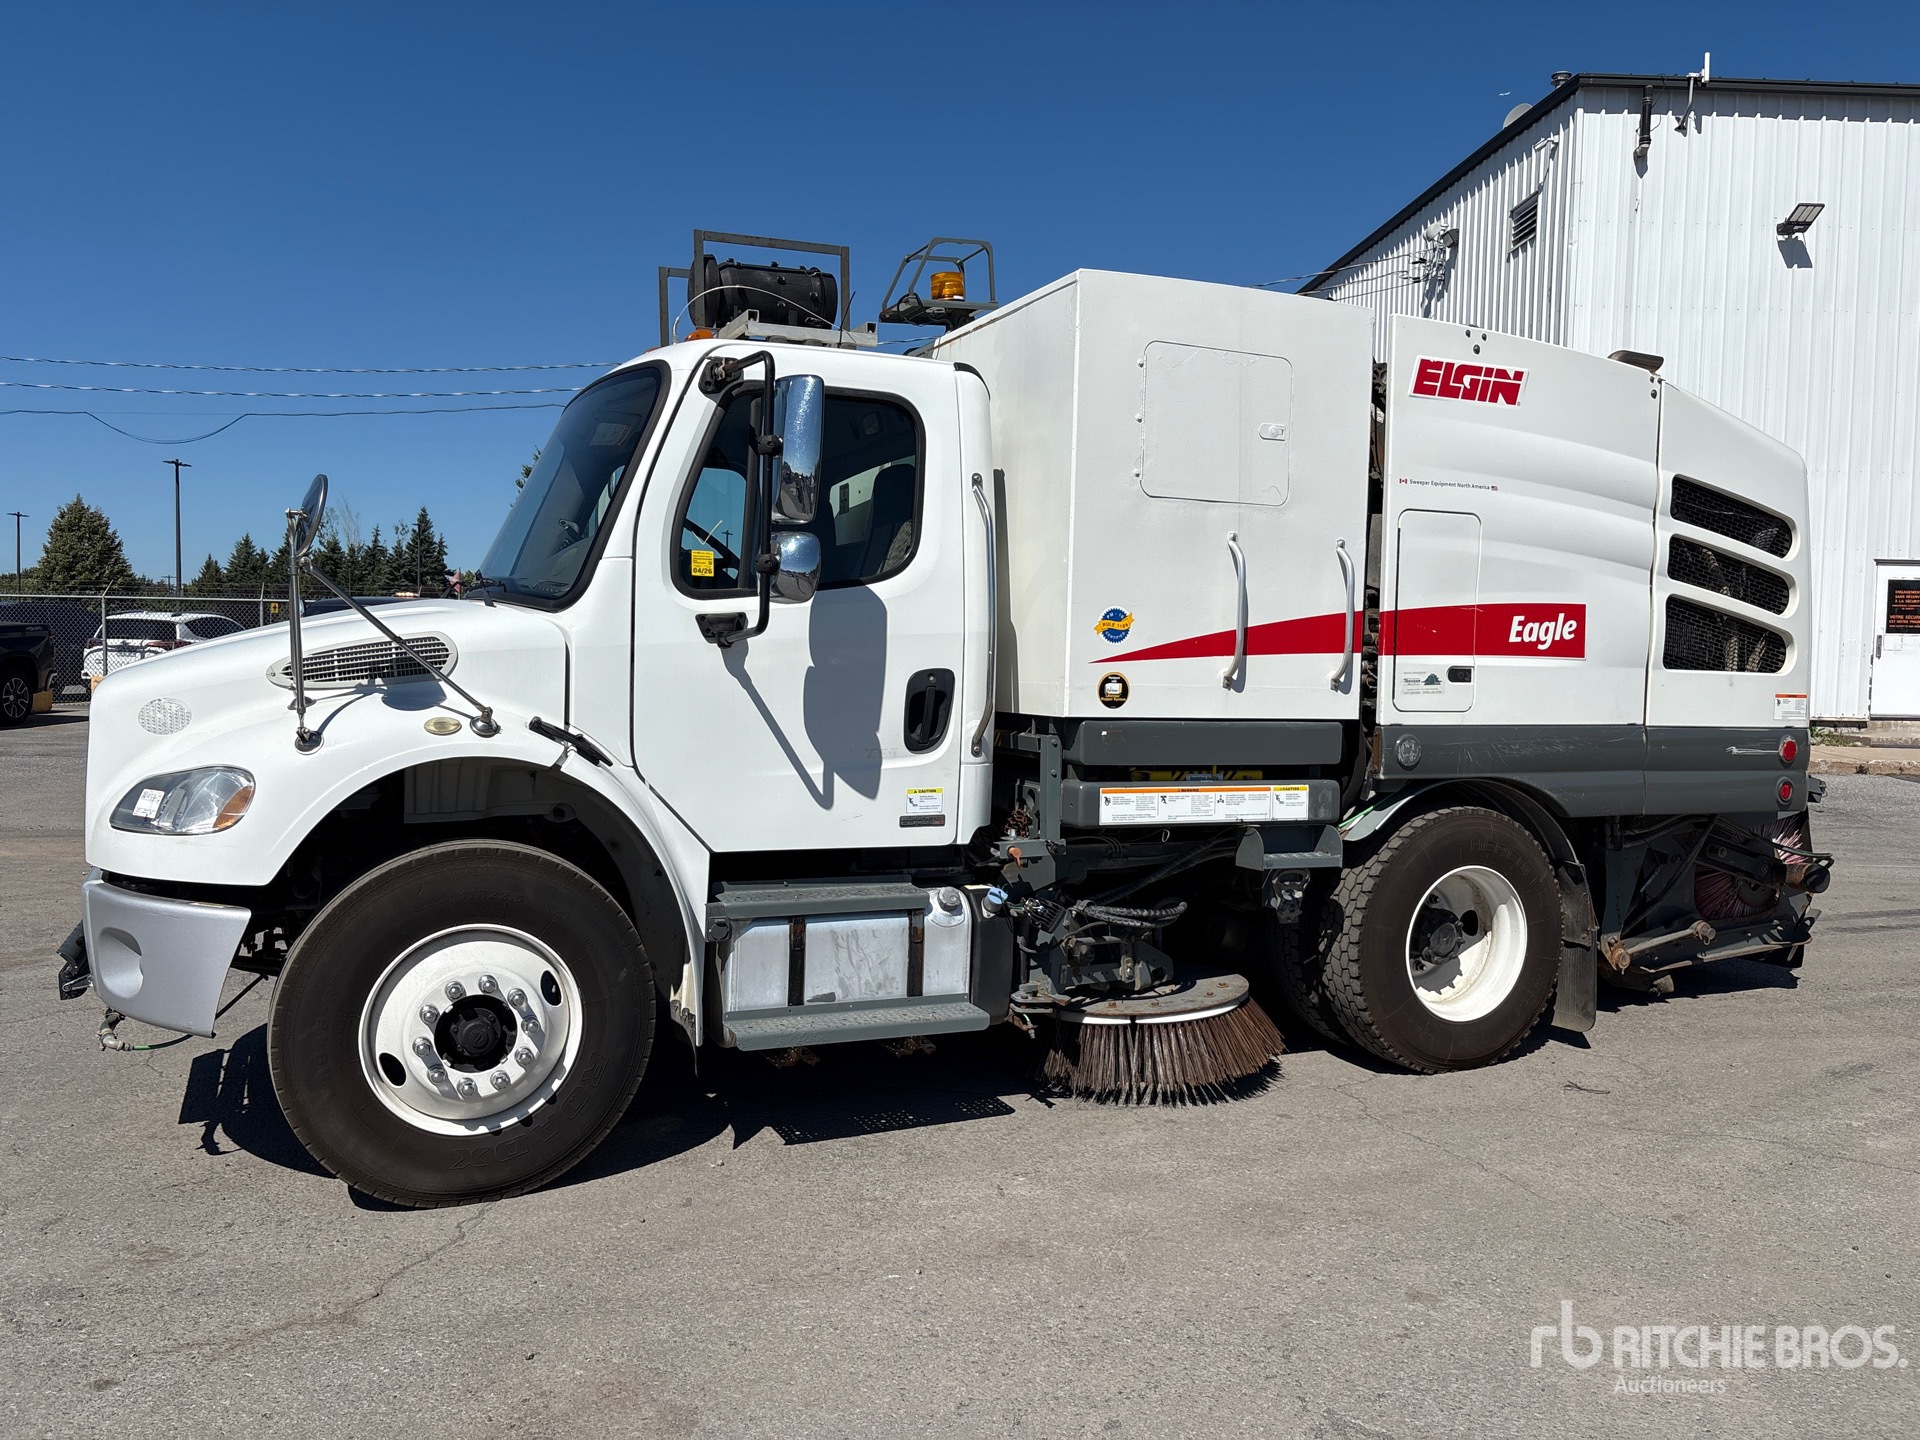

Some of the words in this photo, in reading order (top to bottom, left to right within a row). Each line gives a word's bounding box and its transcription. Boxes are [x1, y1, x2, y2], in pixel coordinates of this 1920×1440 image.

[1413, 358, 1524, 406] ELGIN
[1431, 480, 1456, 488] Equipment
[693, 567, 712, 575] 04/26
[1508, 612, 1577, 650] Eagle
[449, 1050, 609, 1170] ROADX
